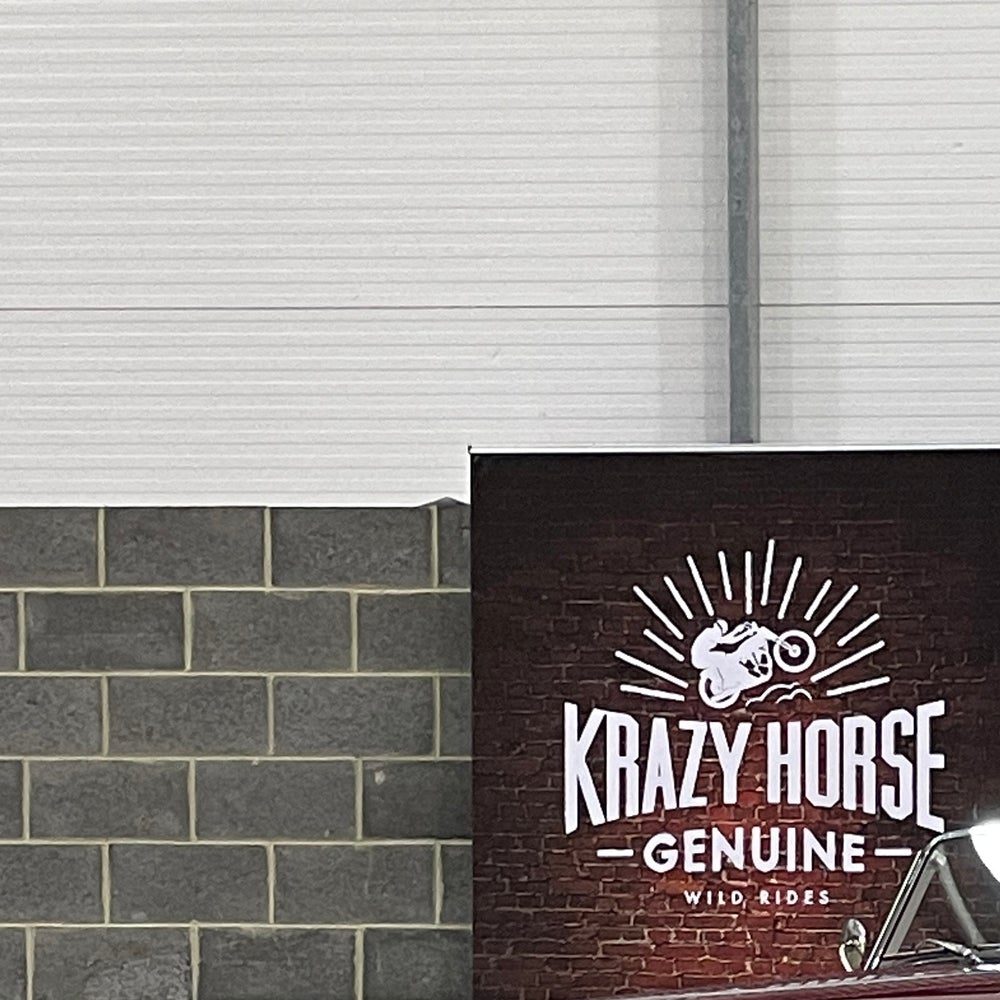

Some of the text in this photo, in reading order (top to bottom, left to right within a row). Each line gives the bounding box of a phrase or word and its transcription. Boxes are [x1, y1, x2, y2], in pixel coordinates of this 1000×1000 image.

[564, 700, 945, 835] KRAZY HORSE
[643, 827, 866, 873] GENUINE
[684, 889, 830, 905] WILD RIDES
